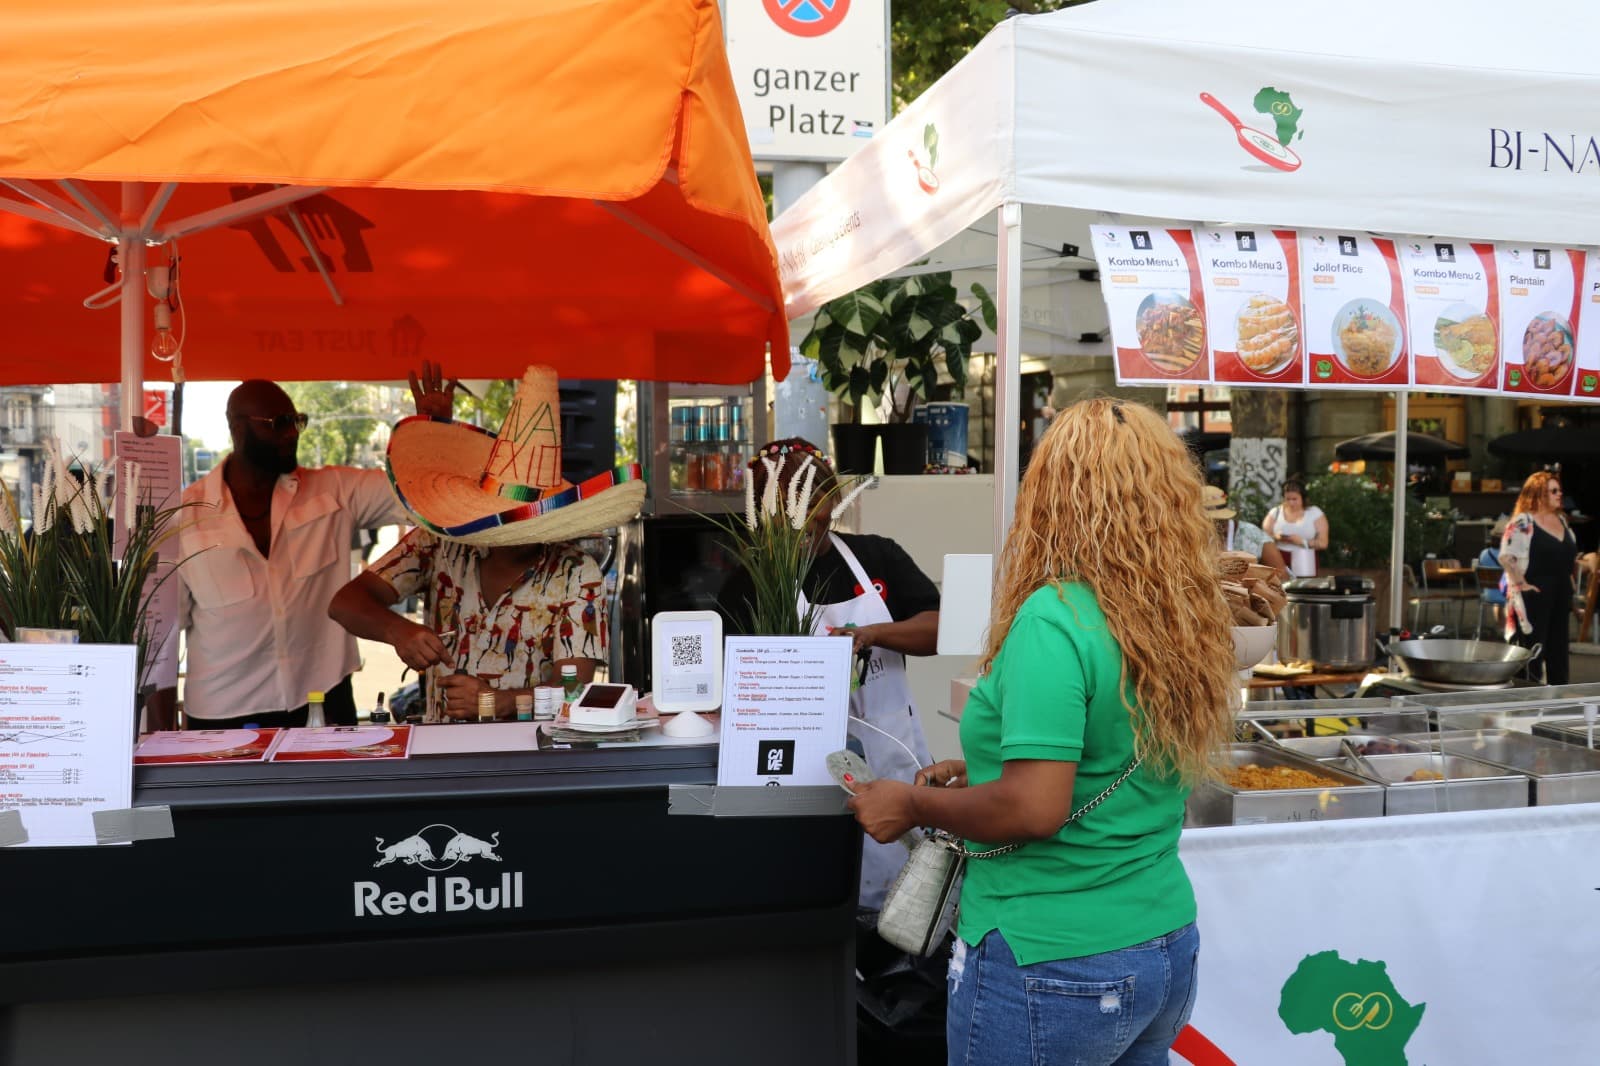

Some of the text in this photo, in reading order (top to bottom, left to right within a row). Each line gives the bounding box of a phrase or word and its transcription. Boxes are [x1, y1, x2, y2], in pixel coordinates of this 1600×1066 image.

[753, 67, 860, 96] ganzer
[769, 103, 846, 136] Platz
[1108, 256, 1180, 267] Kombo Menu 1
[1212, 258, 1283, 271] Kombo Menu 3
[1313, 263, 1364, 274] Jollof Rice
[1413, 268, 1482, 281] Kombo Menu 2
[1509, 275, 1545, 287] Plantain
[354, 871, 524, 917] Red Bull
